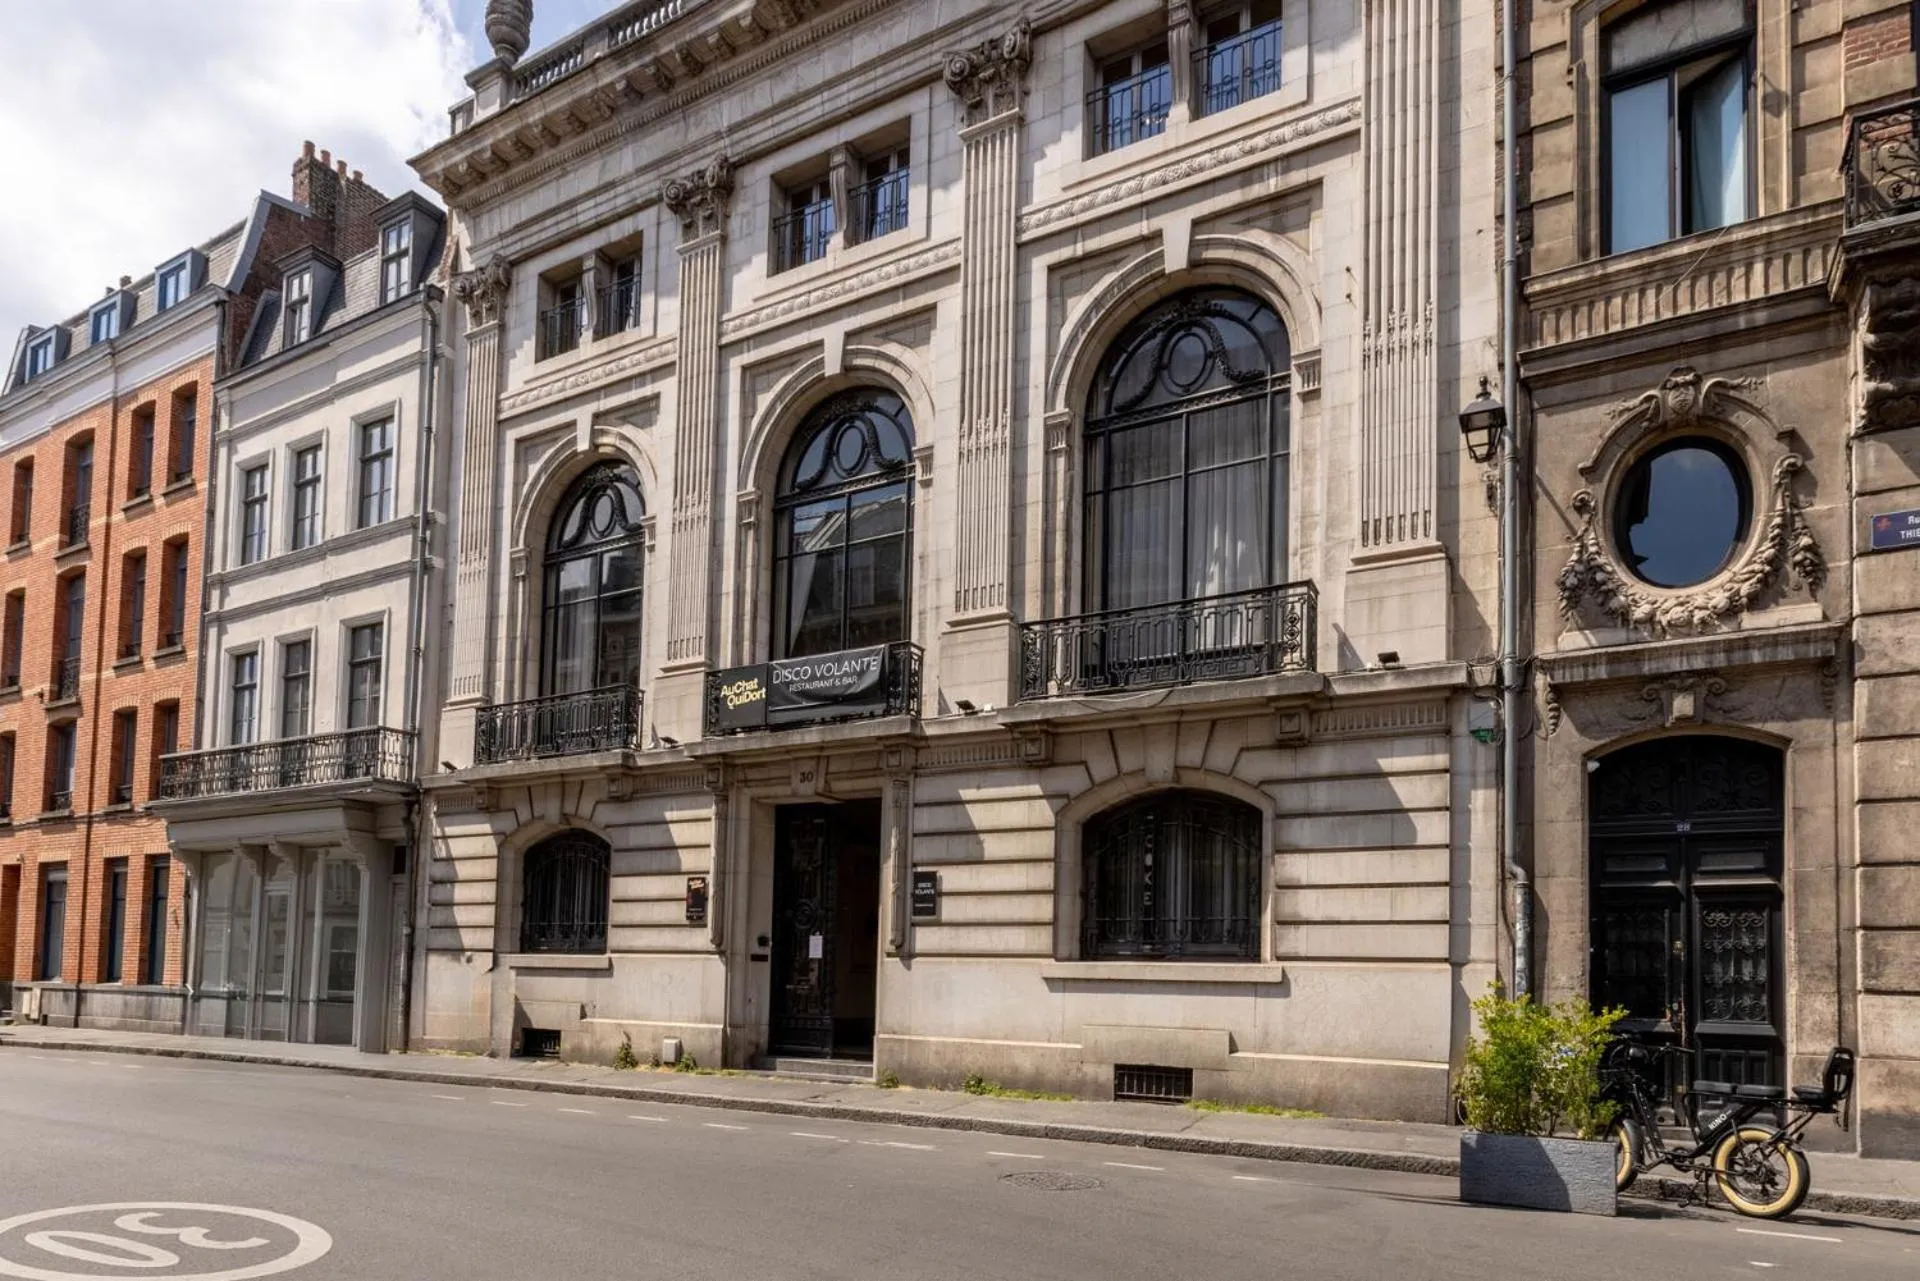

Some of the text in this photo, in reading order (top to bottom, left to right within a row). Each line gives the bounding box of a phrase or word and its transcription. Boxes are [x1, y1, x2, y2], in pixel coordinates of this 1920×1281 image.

[772, 656, 880, 684] DISCO VOLANTE
[721, 677, 759, 698] AuChat
[789, 675, 858, 693] RESTAURANT & BAR
[727, 687, 766, 710] QuiDort
[800, 771, 814, 783] 30
[24, 1211, 271, 1268] 30
